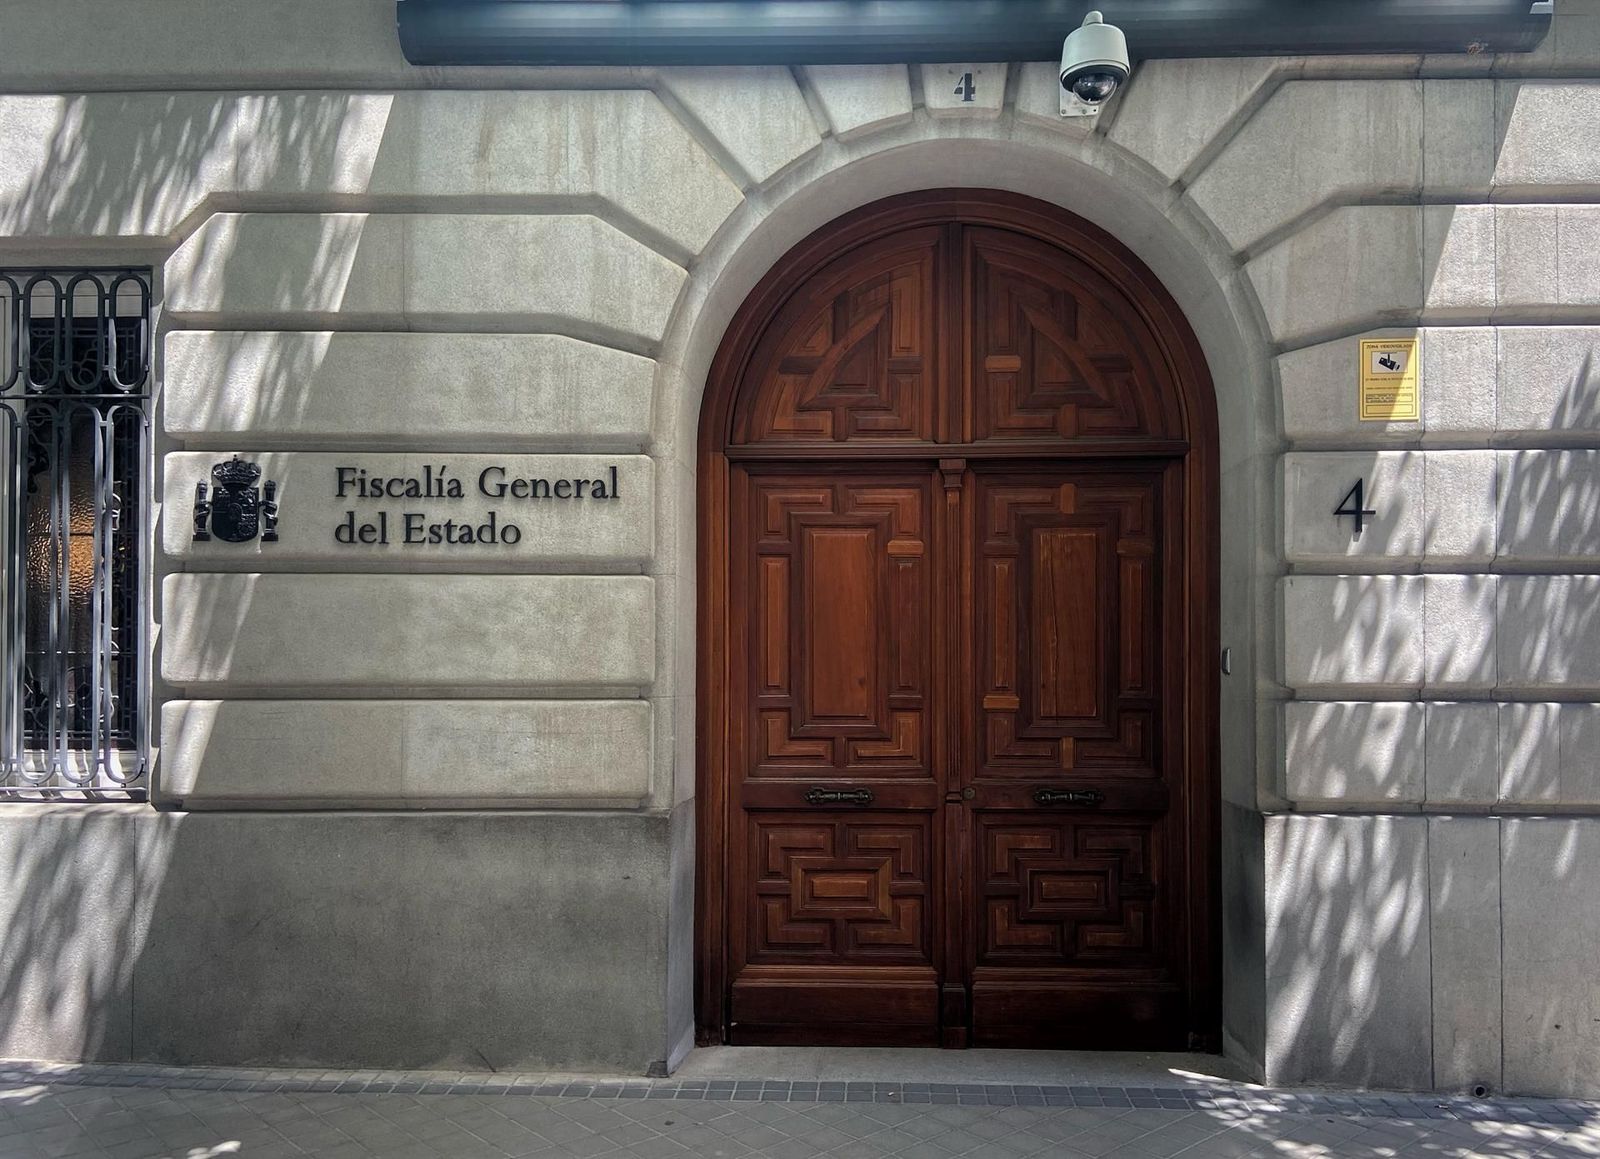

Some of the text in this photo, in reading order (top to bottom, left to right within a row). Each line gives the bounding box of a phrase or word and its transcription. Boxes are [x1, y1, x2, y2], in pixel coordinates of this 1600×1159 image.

[953, 73, 976, 102] 4
[335, 465, 621, 499] Fiscalía General
[1333, 477, 1376, 533] 4
[334, 511, 522, 545] del Estado
